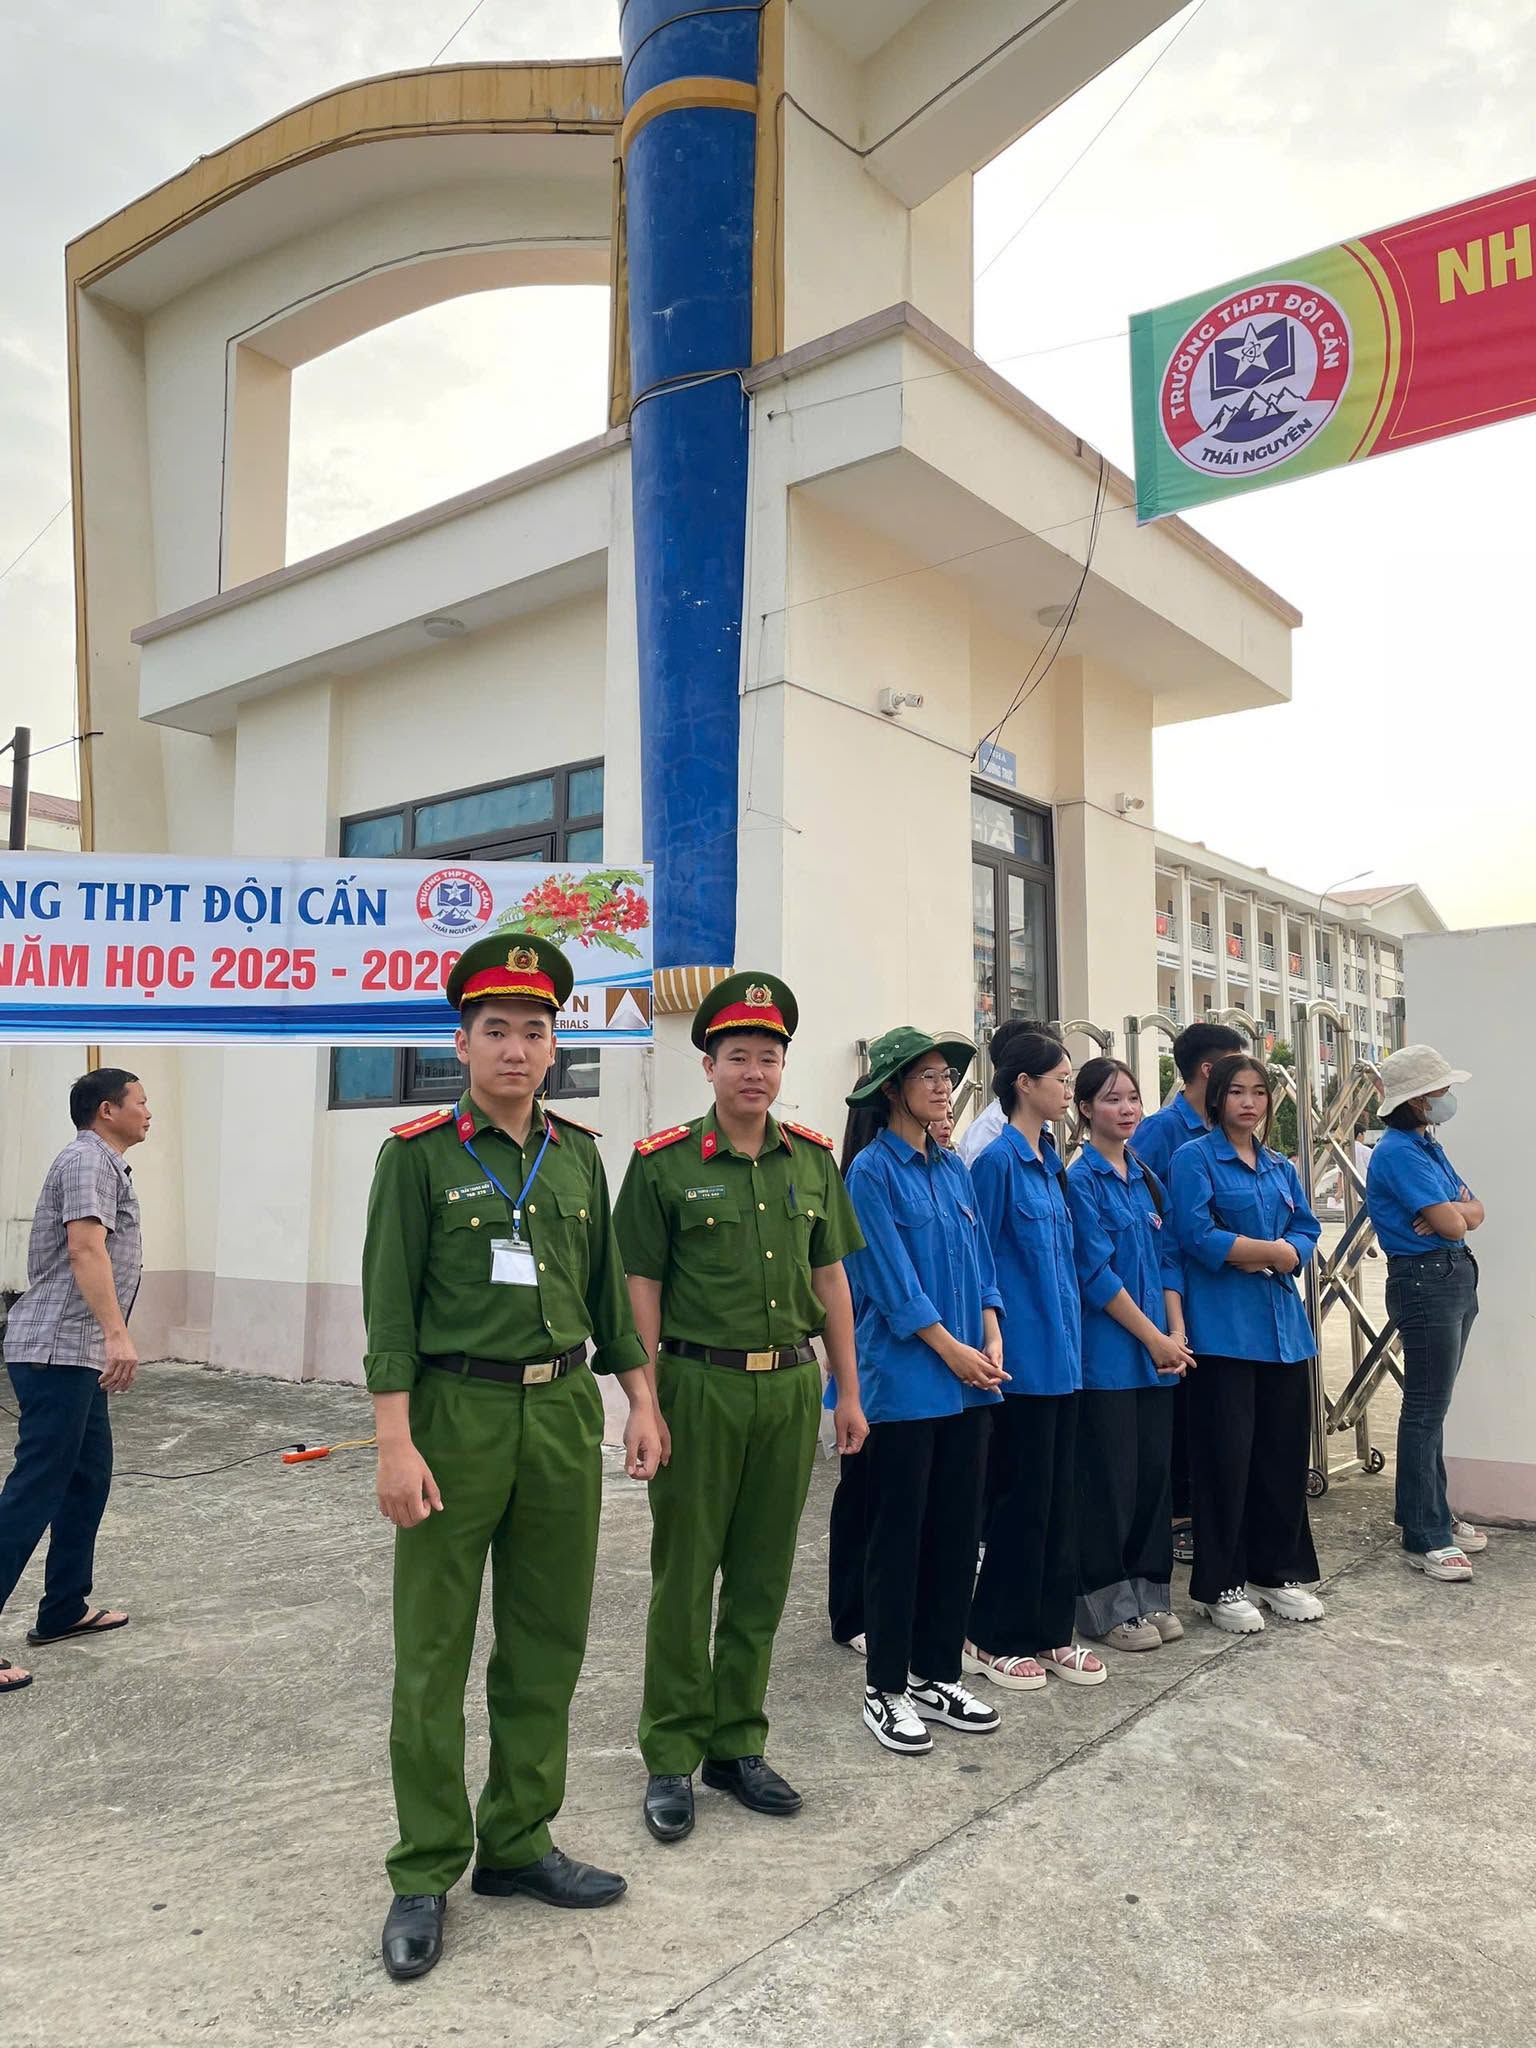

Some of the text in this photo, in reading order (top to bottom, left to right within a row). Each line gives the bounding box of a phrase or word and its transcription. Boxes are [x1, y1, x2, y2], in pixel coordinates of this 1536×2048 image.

[1437, 223, 1533, 304] NH
[1170, 292, 1346, 420] TRƯỜNG THPT ĐỘI CẤN
[1201, 418, 1313, 465] THÁI NGUYÊN
[442, 870, 468, 879] THPT
[77, 882, 190, 922] THPT
[202, 876, 282, 933] ĐỘI
[298, 875, 388, 926] CẤN
[105, 945, 195, 998] HỌC
[210, 947, 316, 990] 2025
[331, 968, 347, 977] -
